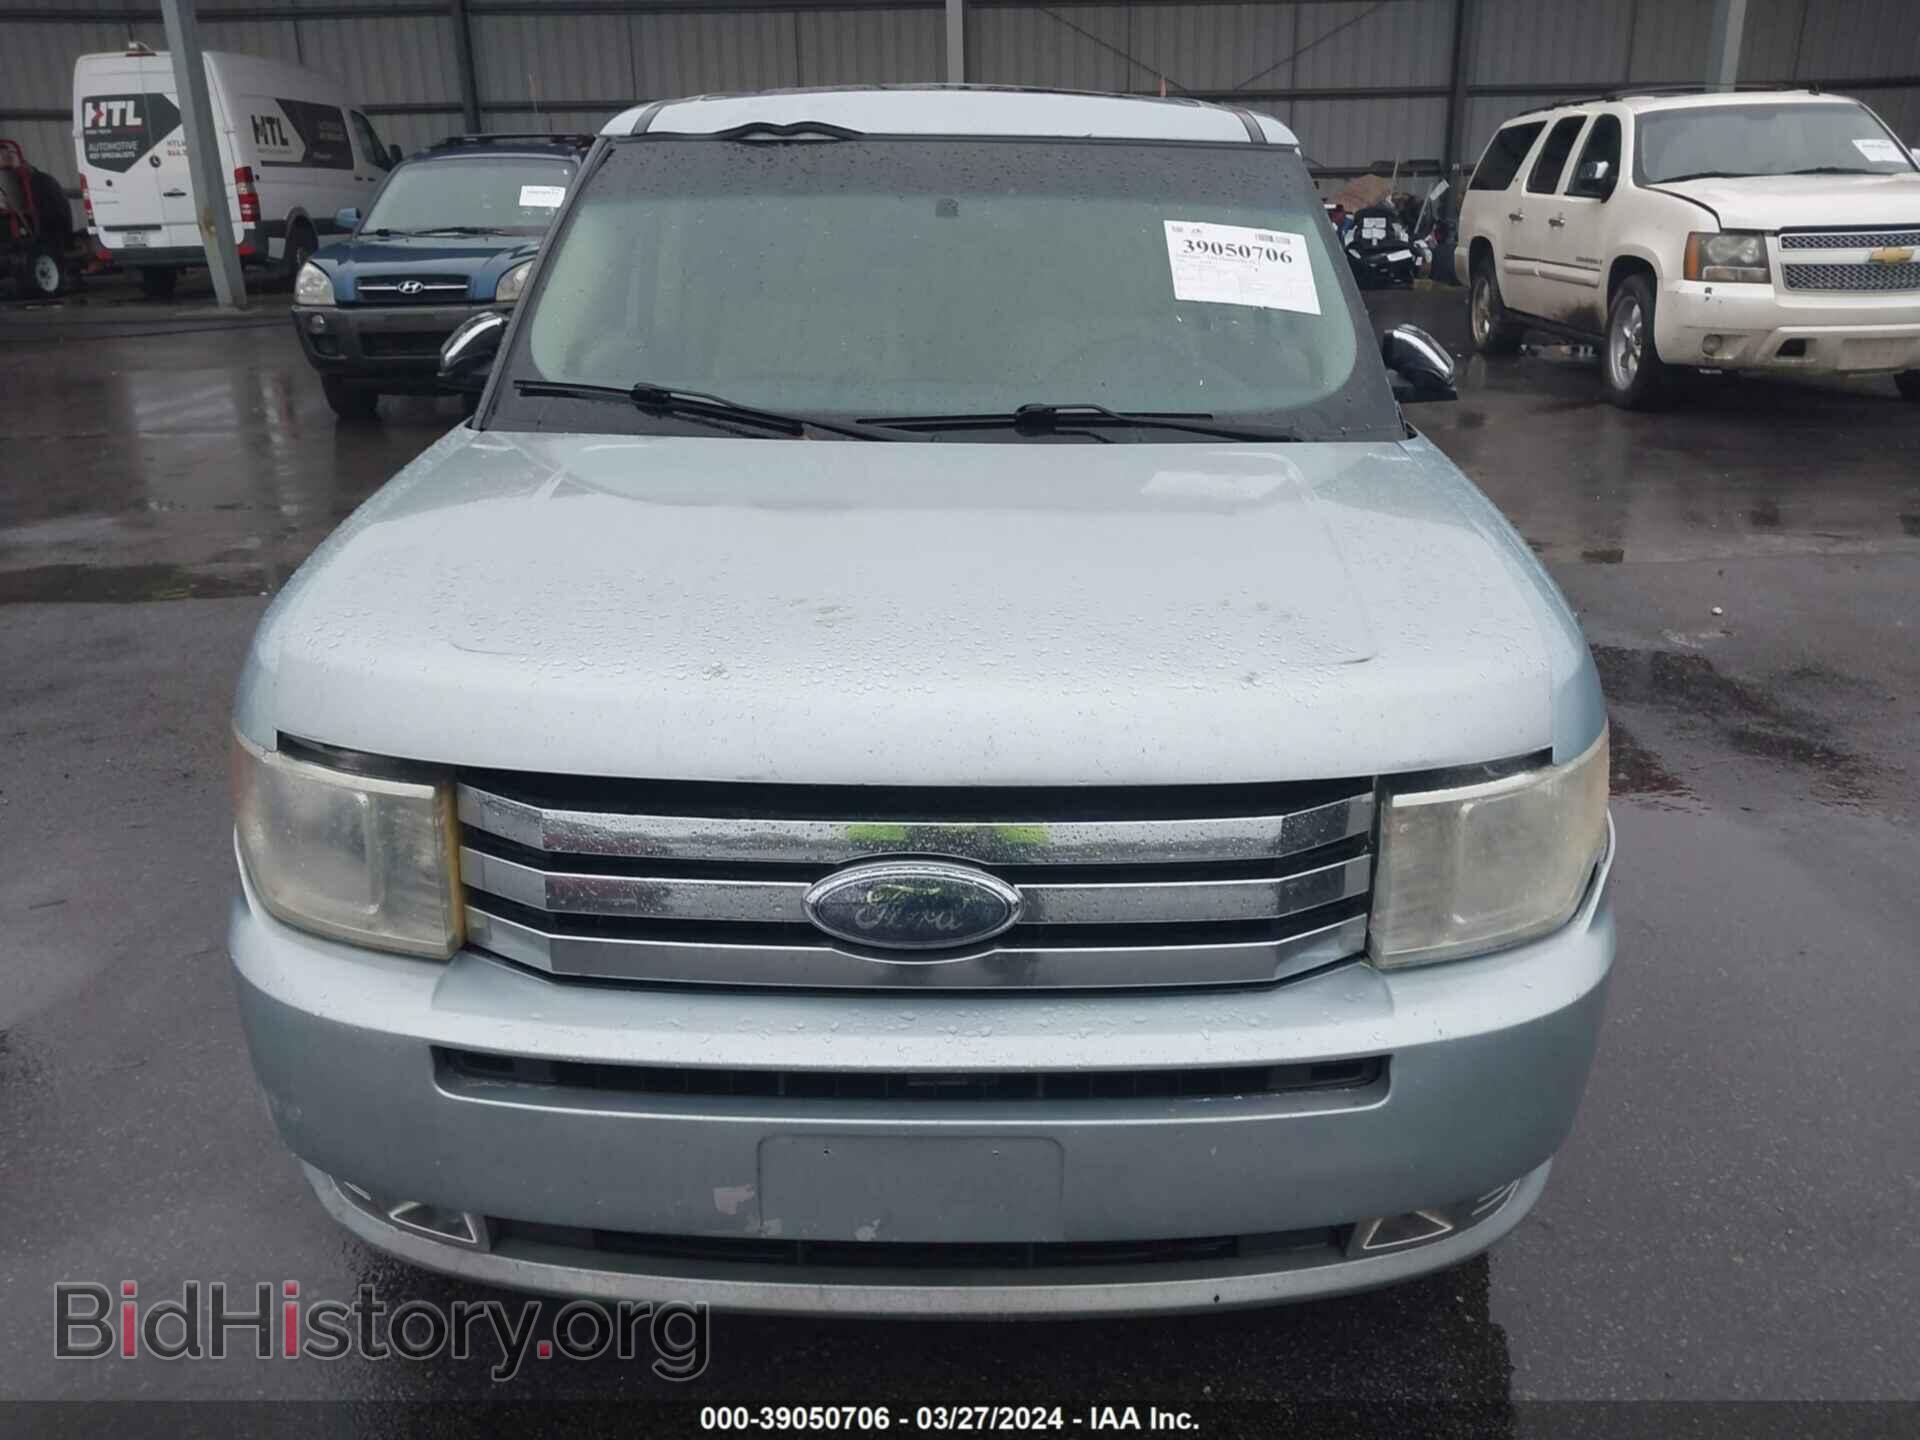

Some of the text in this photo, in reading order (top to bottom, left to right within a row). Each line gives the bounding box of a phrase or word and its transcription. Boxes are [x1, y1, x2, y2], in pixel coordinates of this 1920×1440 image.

[85, 101, 142, 127] HTL
[251, 115, 289, 146] HTL
[88, 140, 138, 151] AUTOMOTIVE
[1183, 239, 1293, 264] 39050706
[854, 883, 964, 930] Ford
